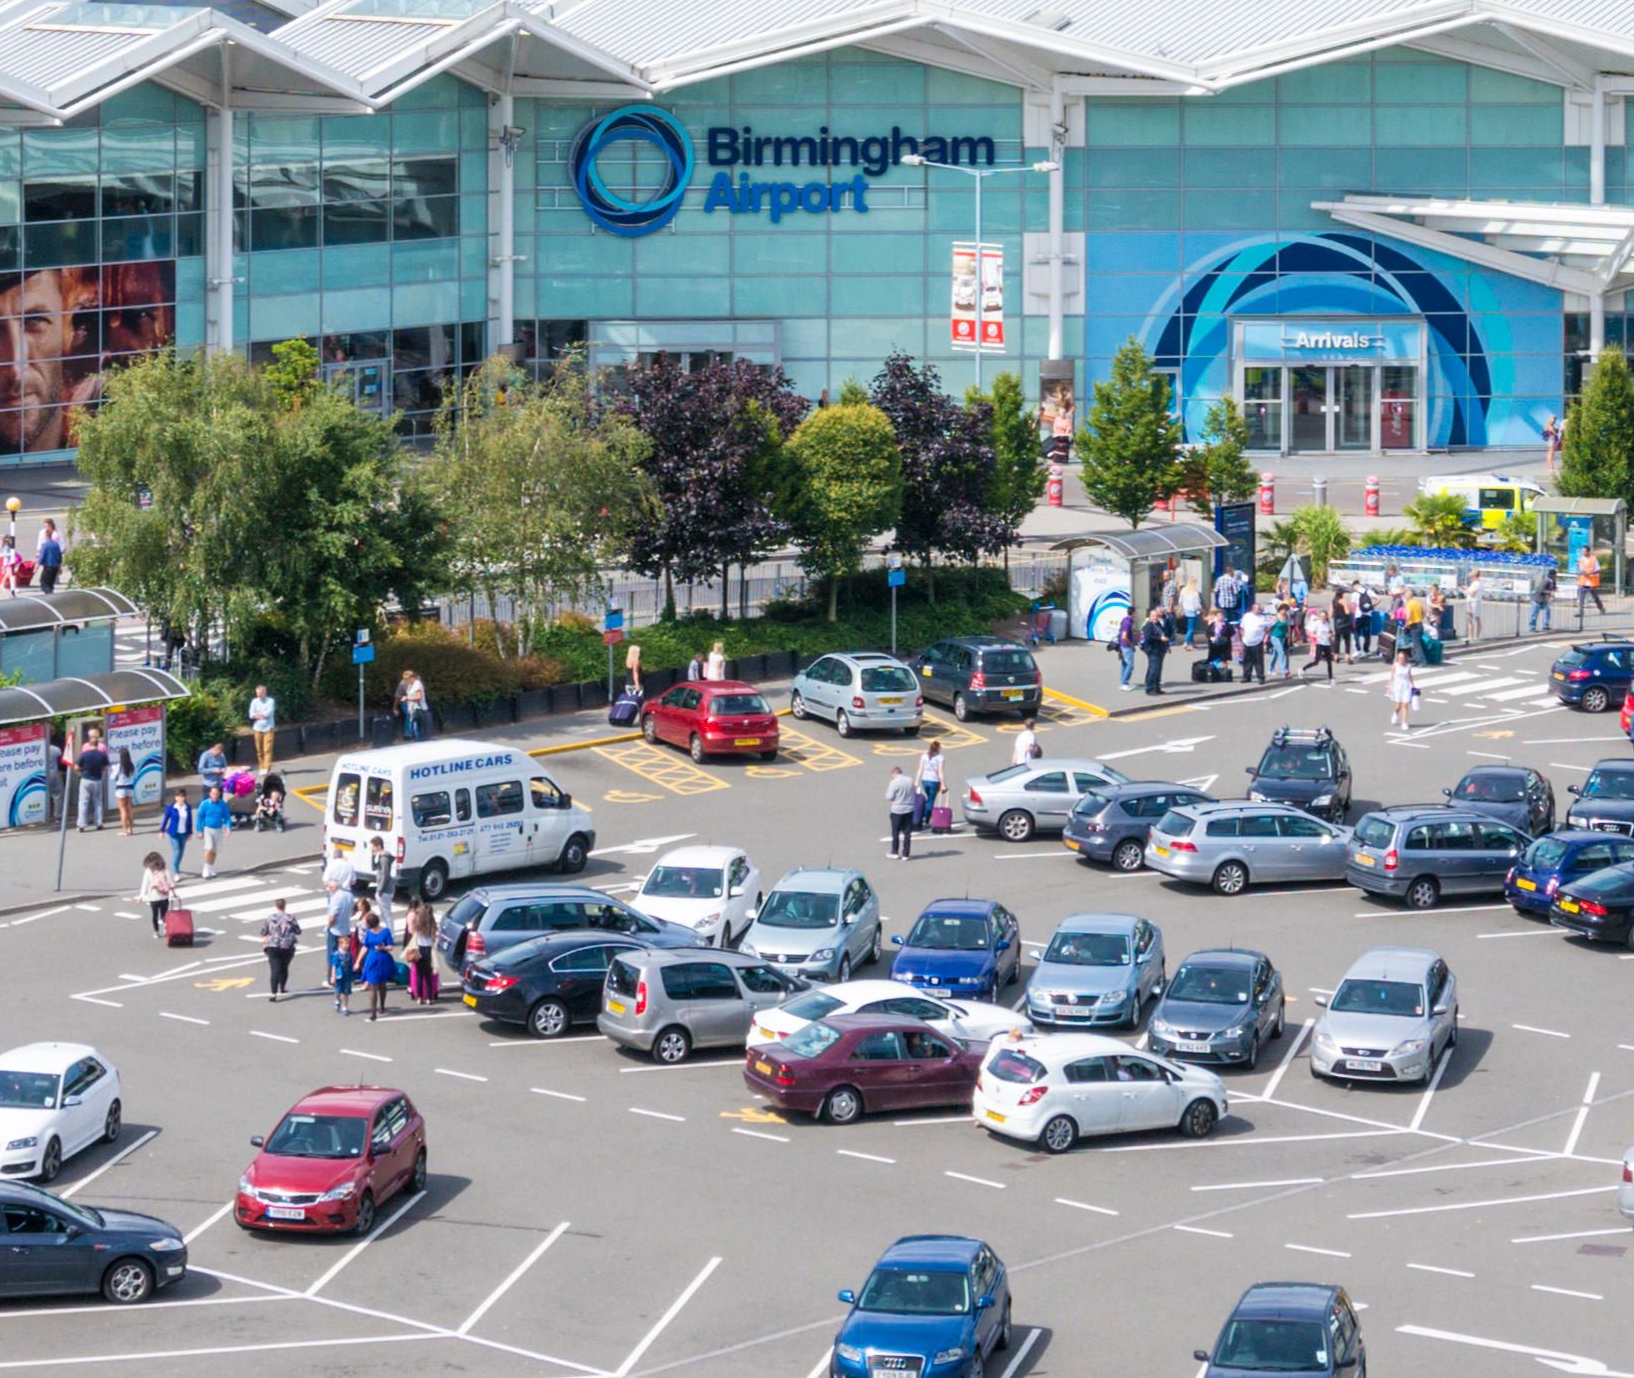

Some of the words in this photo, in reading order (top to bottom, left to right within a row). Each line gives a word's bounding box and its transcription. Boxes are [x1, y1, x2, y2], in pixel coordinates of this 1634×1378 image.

[707, 126, 995, 176] Birmingham
[703, 172, 869, 224] Airport
[1295, 331, 1370, 348] Arrivals
[109, 729, 138, 739] Please
[141, 726, 157, 736] pay
[24, 744, 41, 755] pay
[131, 739, 160, 750] before
[14, 758, 45, 770] before
[410, 759, 473, 779] HOTLINE
[475, 754, 513, 768] CARS
